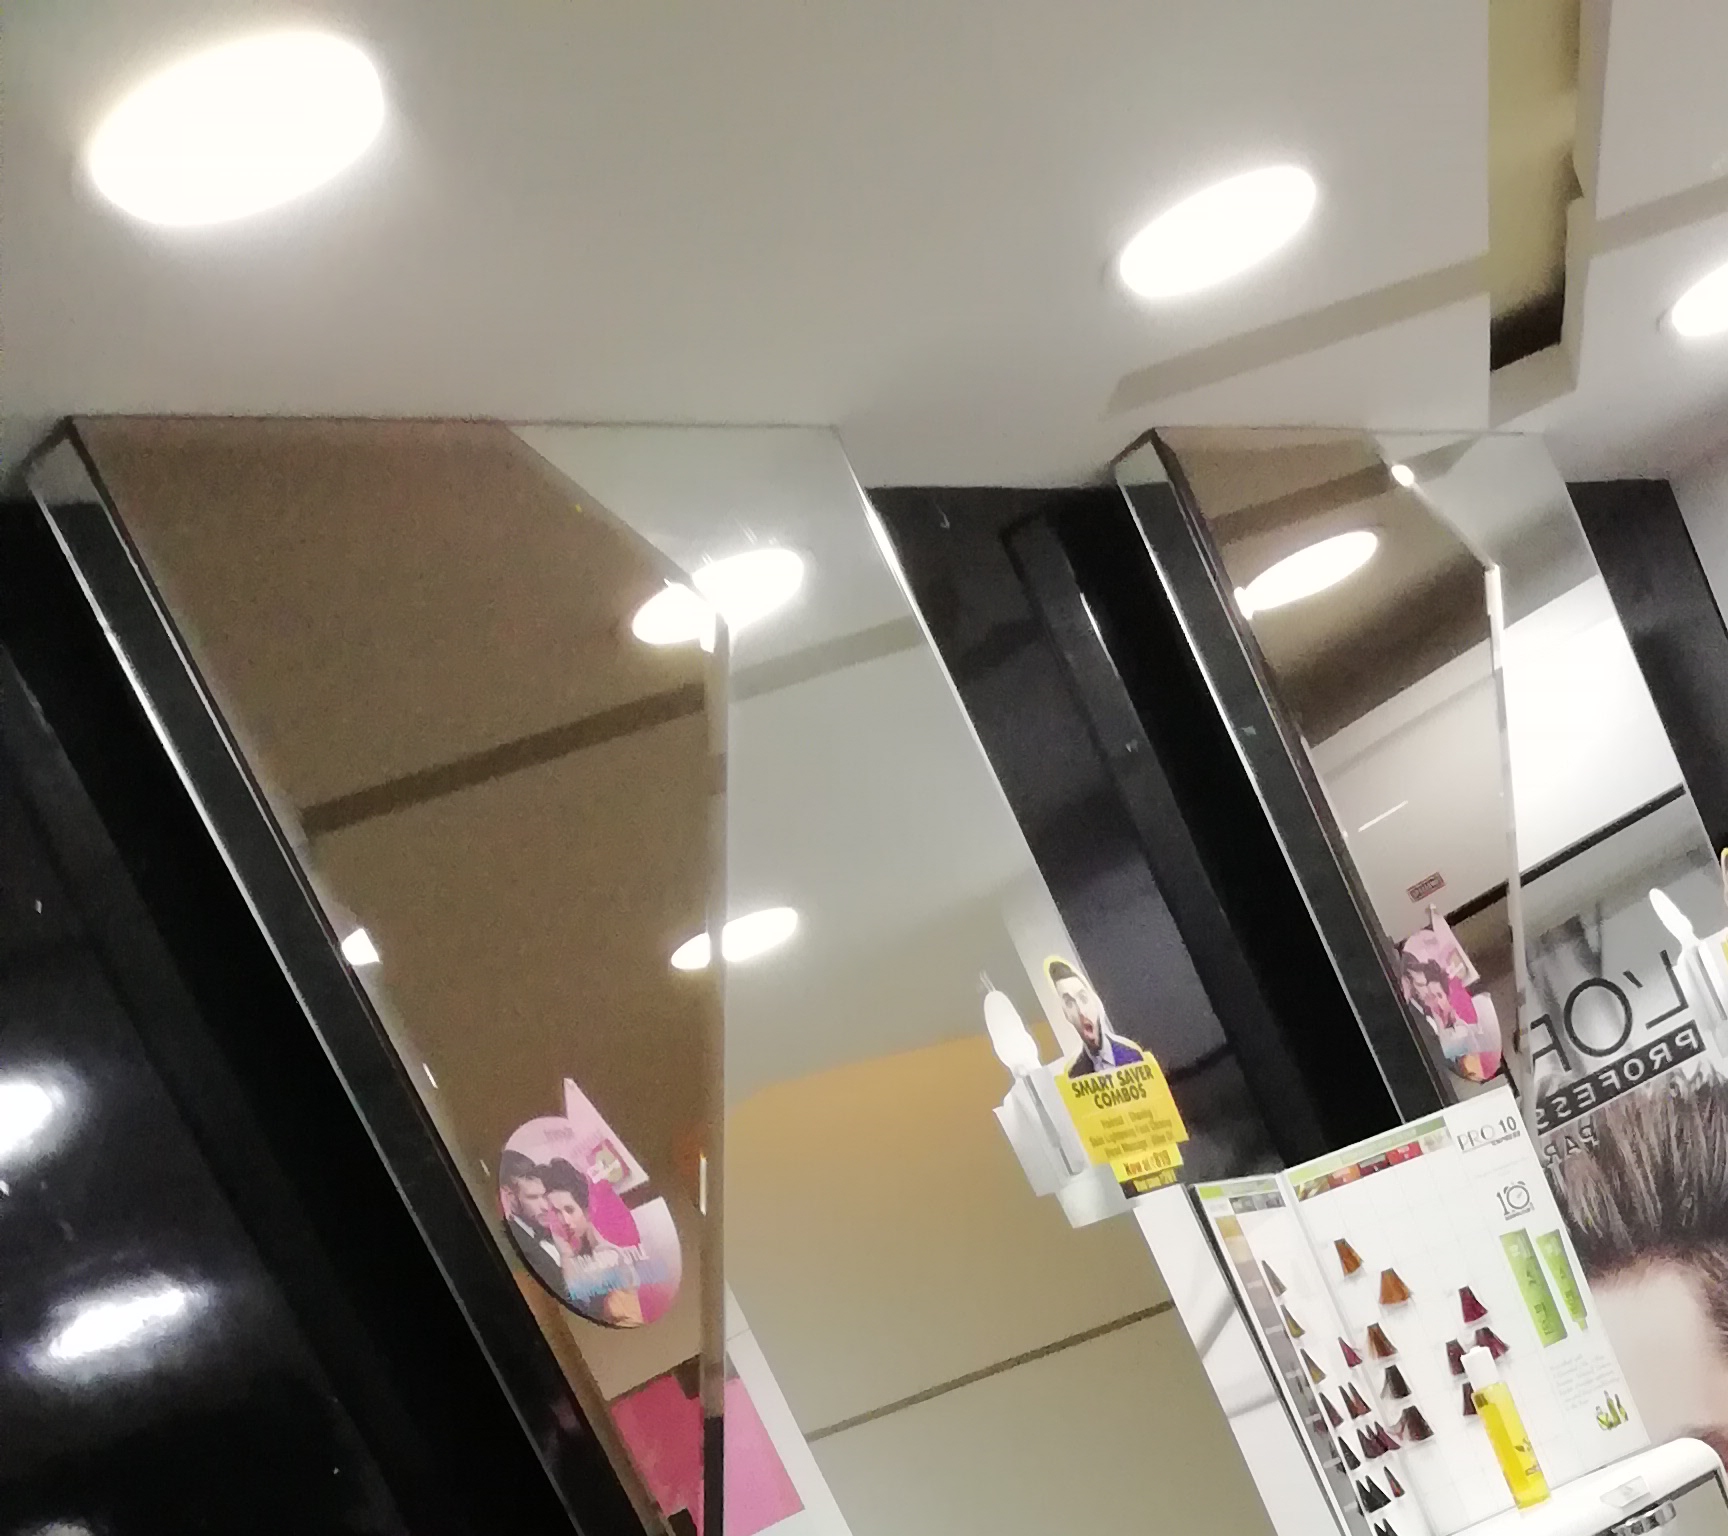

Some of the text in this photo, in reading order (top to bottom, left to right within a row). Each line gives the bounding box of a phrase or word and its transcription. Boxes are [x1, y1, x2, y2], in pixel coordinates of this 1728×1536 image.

[1071, 1064, 1154, 1098] SMART SAVER
[1094, 1084, 1148, 1109] COMBOS
[1456, 1124, 1496, 1151] PRO
[1498, 1116, 1518, 1133] 10
